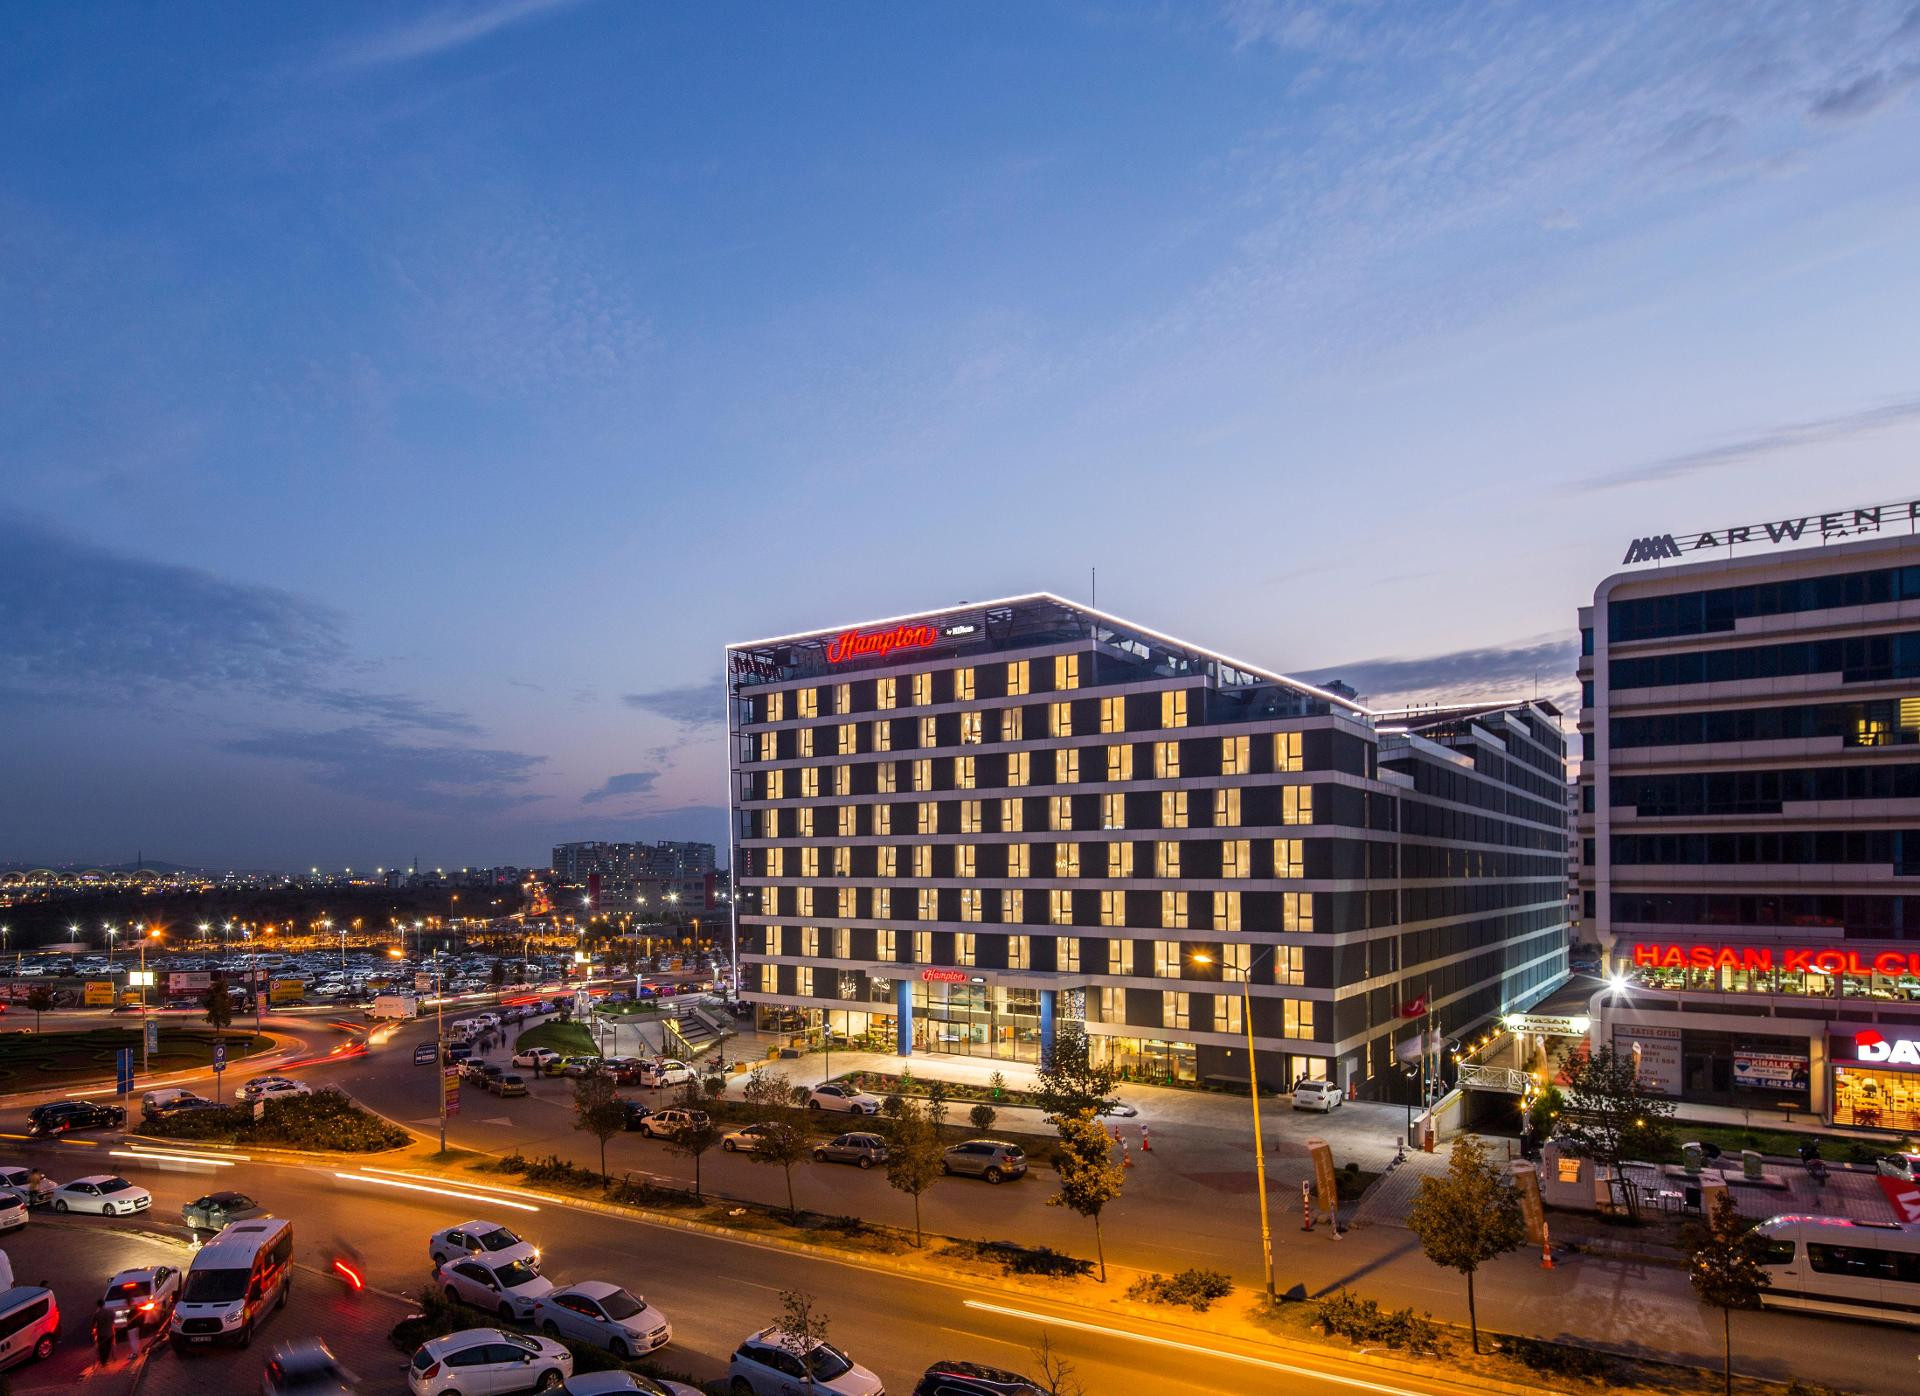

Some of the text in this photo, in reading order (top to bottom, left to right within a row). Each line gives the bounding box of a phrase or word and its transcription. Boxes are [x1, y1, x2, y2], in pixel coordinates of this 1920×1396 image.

[1694, 506, 1881, 549] ARWEN
[827, 625, 937, 663] Hampton
[1634, 944, 1772, 971] HASAN
[922, 968, 967, 982] Hampton
